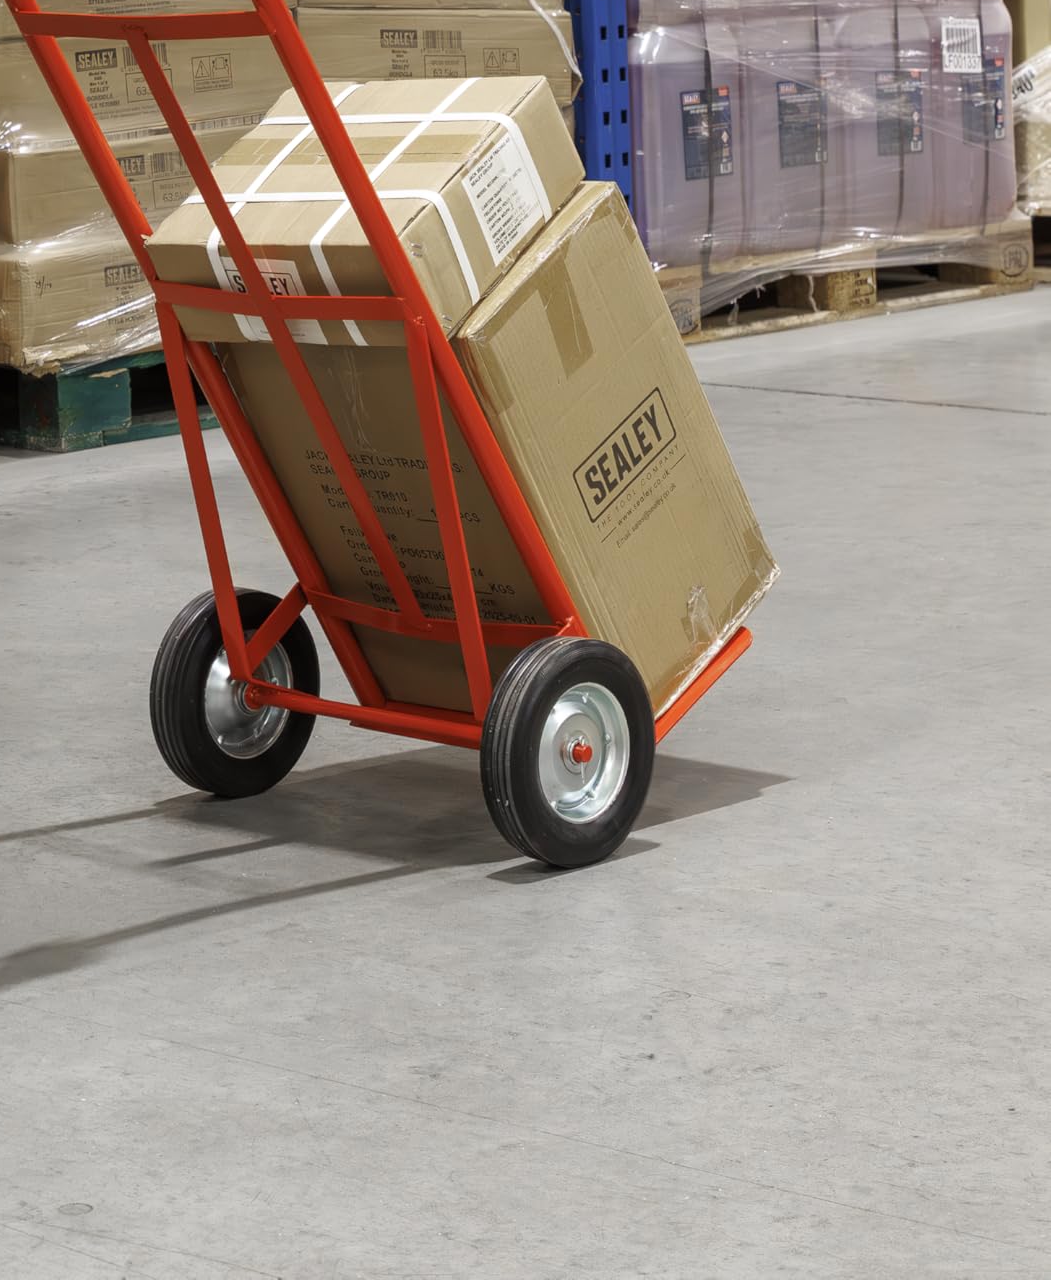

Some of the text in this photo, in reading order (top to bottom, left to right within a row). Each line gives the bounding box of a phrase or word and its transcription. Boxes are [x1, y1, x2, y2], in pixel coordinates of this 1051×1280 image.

[383, 32, 415, 47] SEALEY
[78, 51, 115, 69] SEALEY
[233, 275, 291, 297] SEY
[585, 403, 662, 506] SEALEY
[309, 464, 334, 475] SEA
[378, 455, 394, 467] Ltd
[395, 457, 428, 471] TRAD
[640, 443, 680, 488] COMPANY
[321, 484, 345, 496] Mod
[618, 470, 670, 527] www.sealey.co.uk
[373, 504, 414, 519] uantity:
[489, 583, 516, 596] KGS
